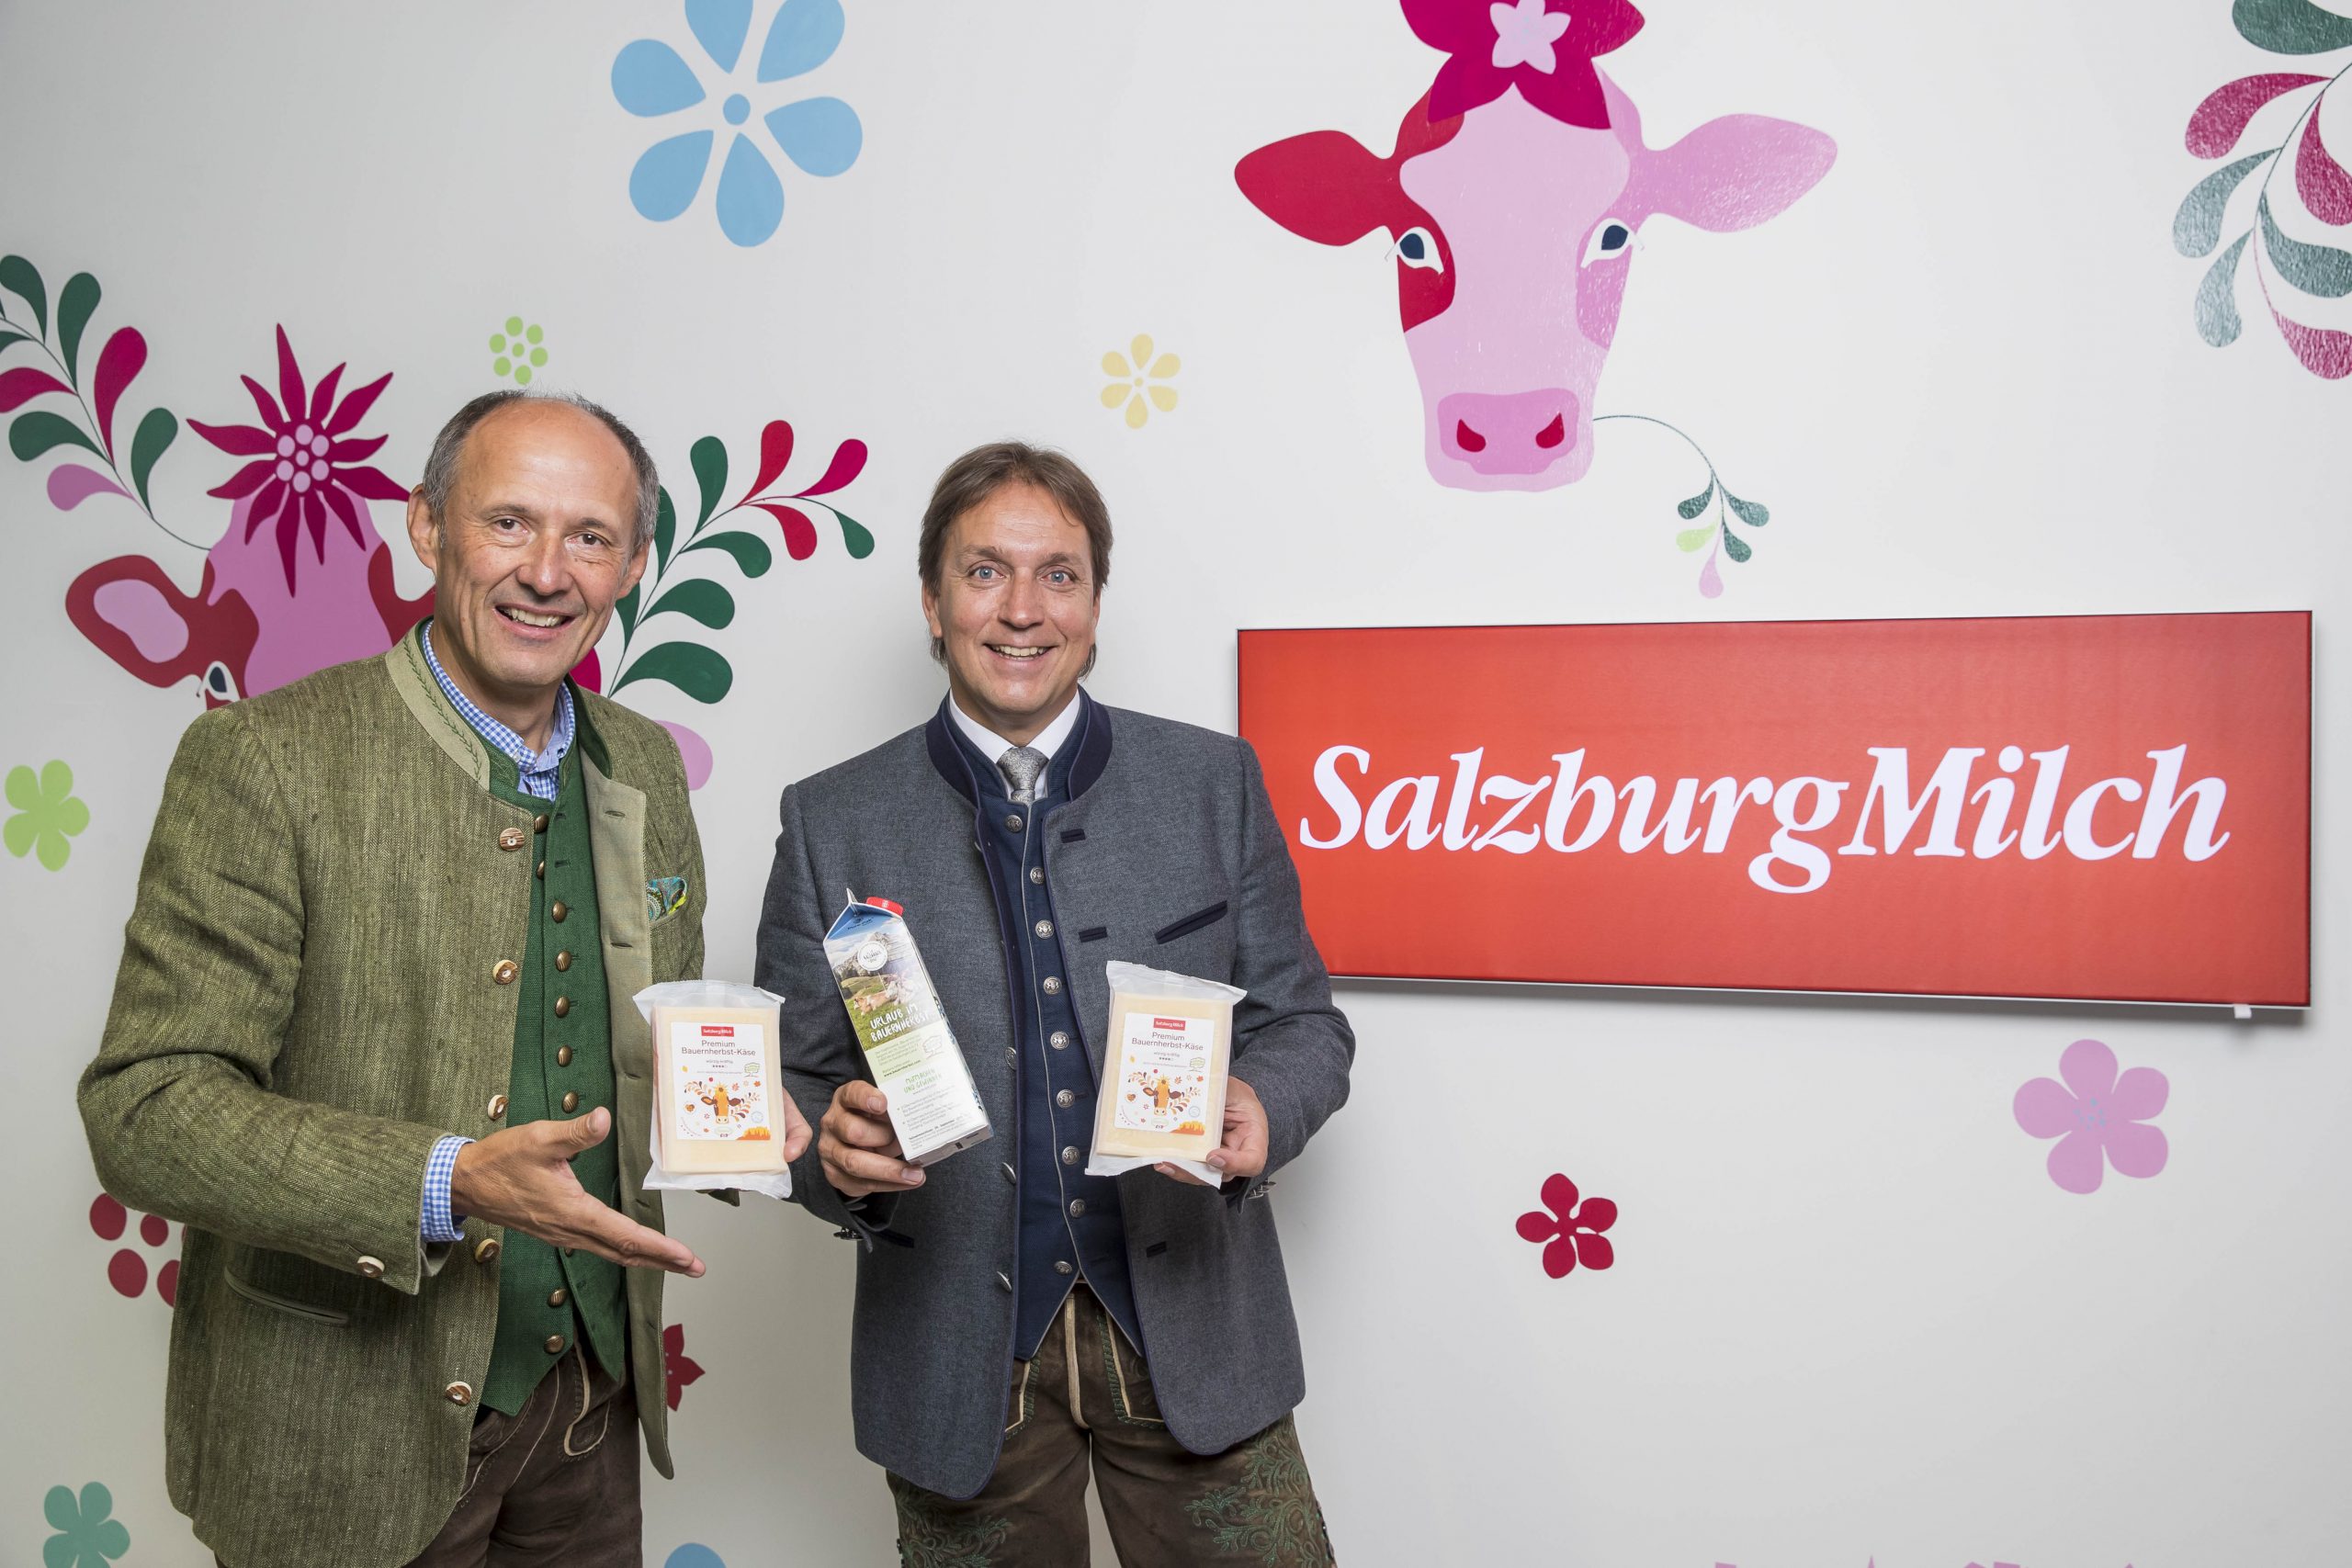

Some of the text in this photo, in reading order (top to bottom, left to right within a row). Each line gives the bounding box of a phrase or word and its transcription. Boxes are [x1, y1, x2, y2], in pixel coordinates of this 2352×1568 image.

[1299, 744, 2231, 894] SalzburgMilch
[870, 1002, 918, 1030] URLAUB IM
[870, 1010, 931, 1043] BAUERNHERBST
[1152, 1032, 1184, 1041] Premium
[681, 1046, 756, 1056] Bauernherbst-Käse
[701, 1040, 736, 1048] Premium
[1131, 1037, 1204, 1051] Bauernherbst-Käse
